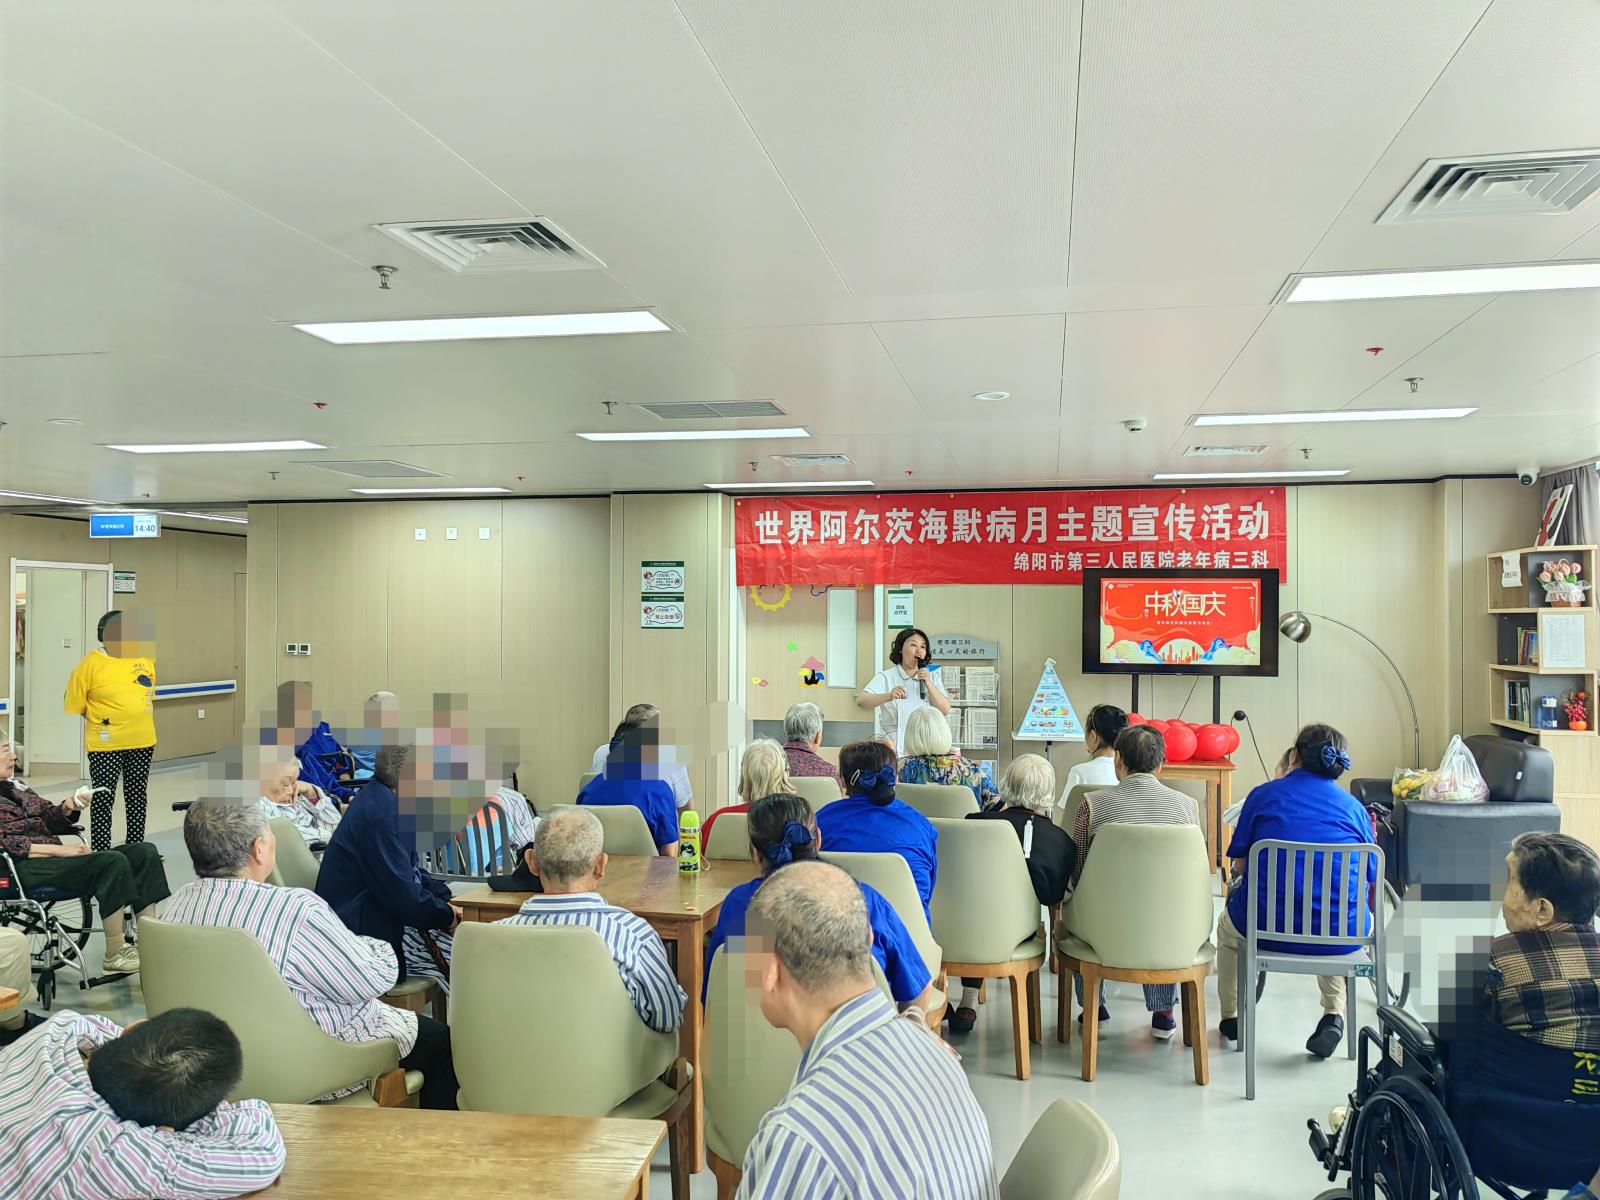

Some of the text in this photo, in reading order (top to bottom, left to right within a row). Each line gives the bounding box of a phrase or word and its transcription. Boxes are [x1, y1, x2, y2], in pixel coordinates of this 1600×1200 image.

[135, 524, 156, 532] 14:40
[755, 502, 1270, 546] 世界阿尔茨海默病月主题宣传活动
[1013, 549, 1270, 572] 绵阳市第三人民医院老年病三科
[1145, 589, 1227, 617] 中秋国庆
